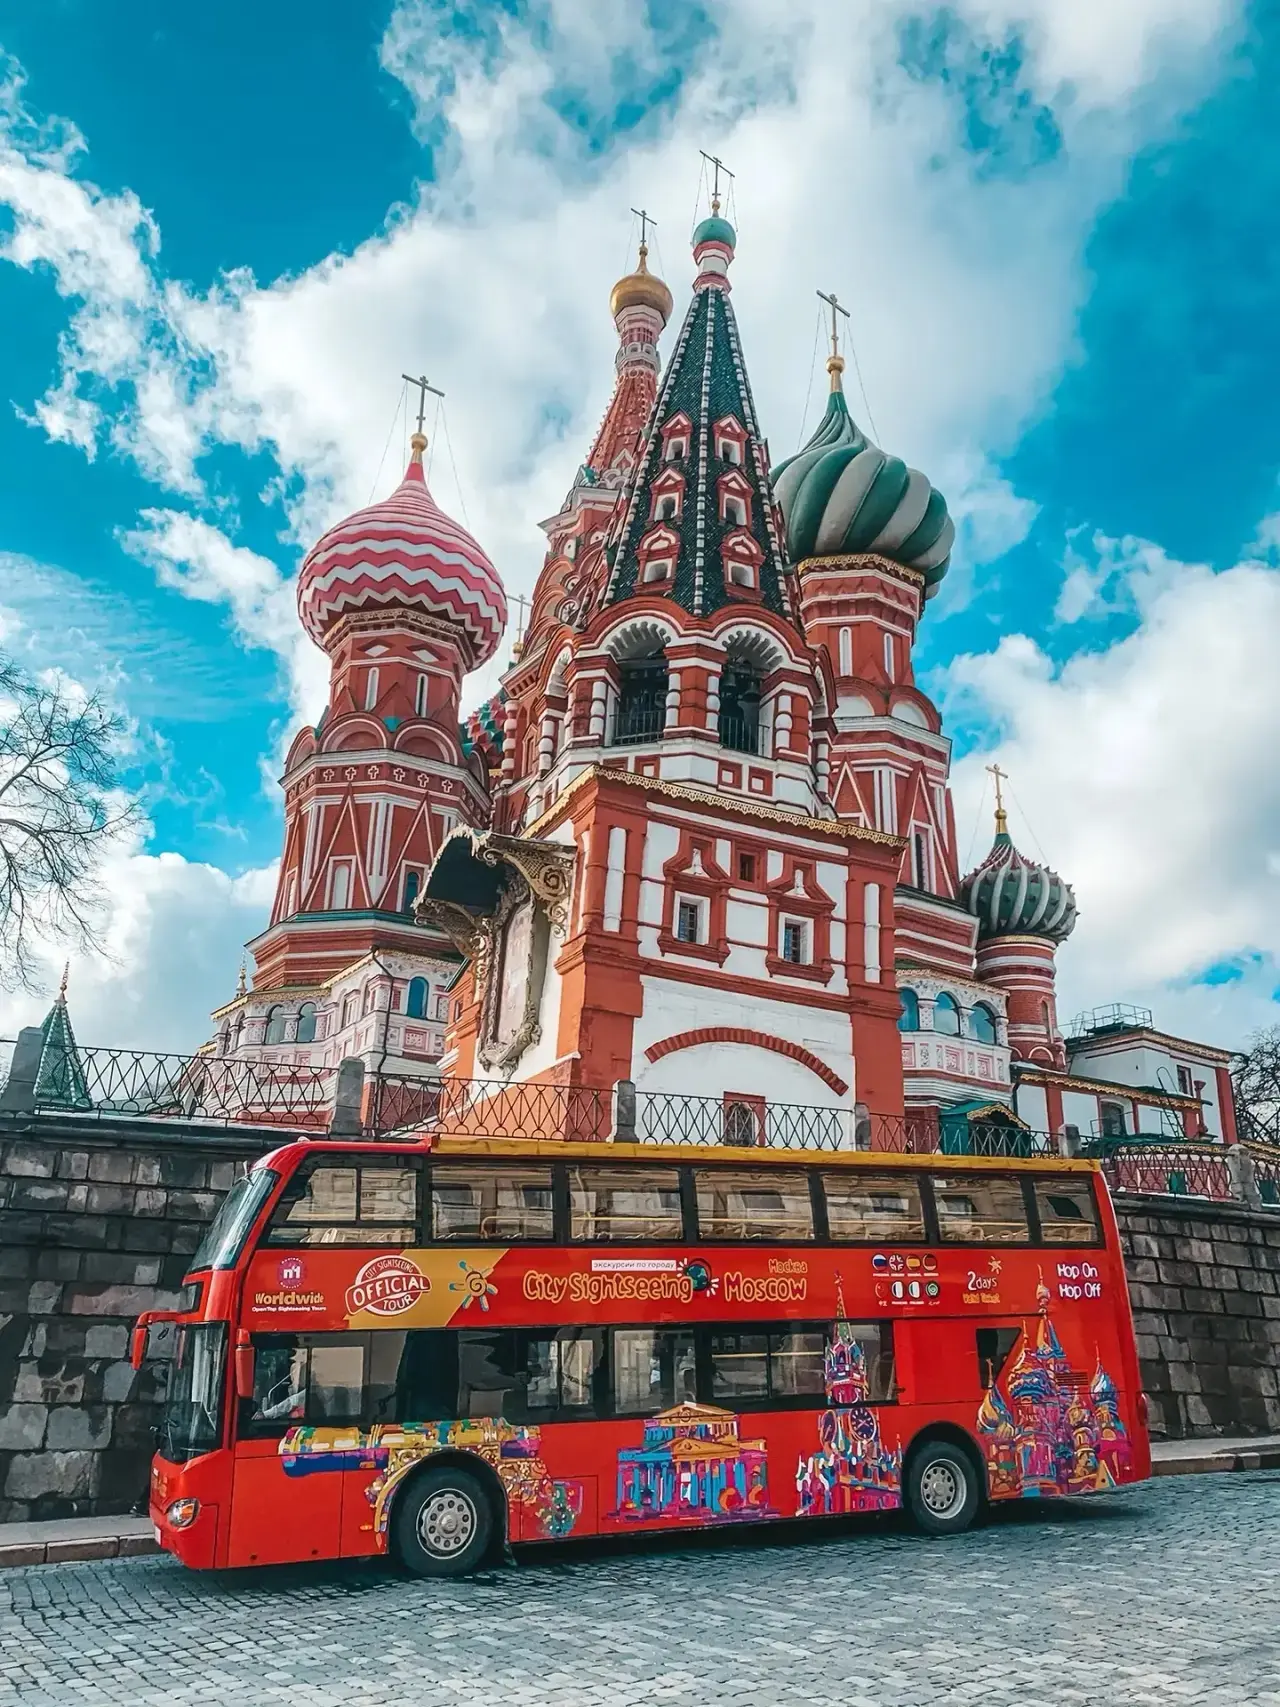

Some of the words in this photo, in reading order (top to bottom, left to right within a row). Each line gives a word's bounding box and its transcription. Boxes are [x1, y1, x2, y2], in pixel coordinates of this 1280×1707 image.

[365, 1267, 377, 1279] CITY
[377, 1259, 414, 1273] SIGHTSEEING
[768, 1259, 808, 1274] Москва
[1057, 1263, 1080, 1280] Hop
[1082, 1262, 1098, 1278] On
[353, 1276, 428, 1307] OFFICIAL
[523, 1270, 567, 1304] City
[569, 1272, 693, 1304] Sightseeing
[1059, 1283, 1082, 1300] Hop
[1084, 1282, 1101, 1298] Off
[255, 1291, 324, 1305] Worldwide
[383, 1294, 413, 1311] TOUR
[277, 1305, 311, 1313] Sightseeing
